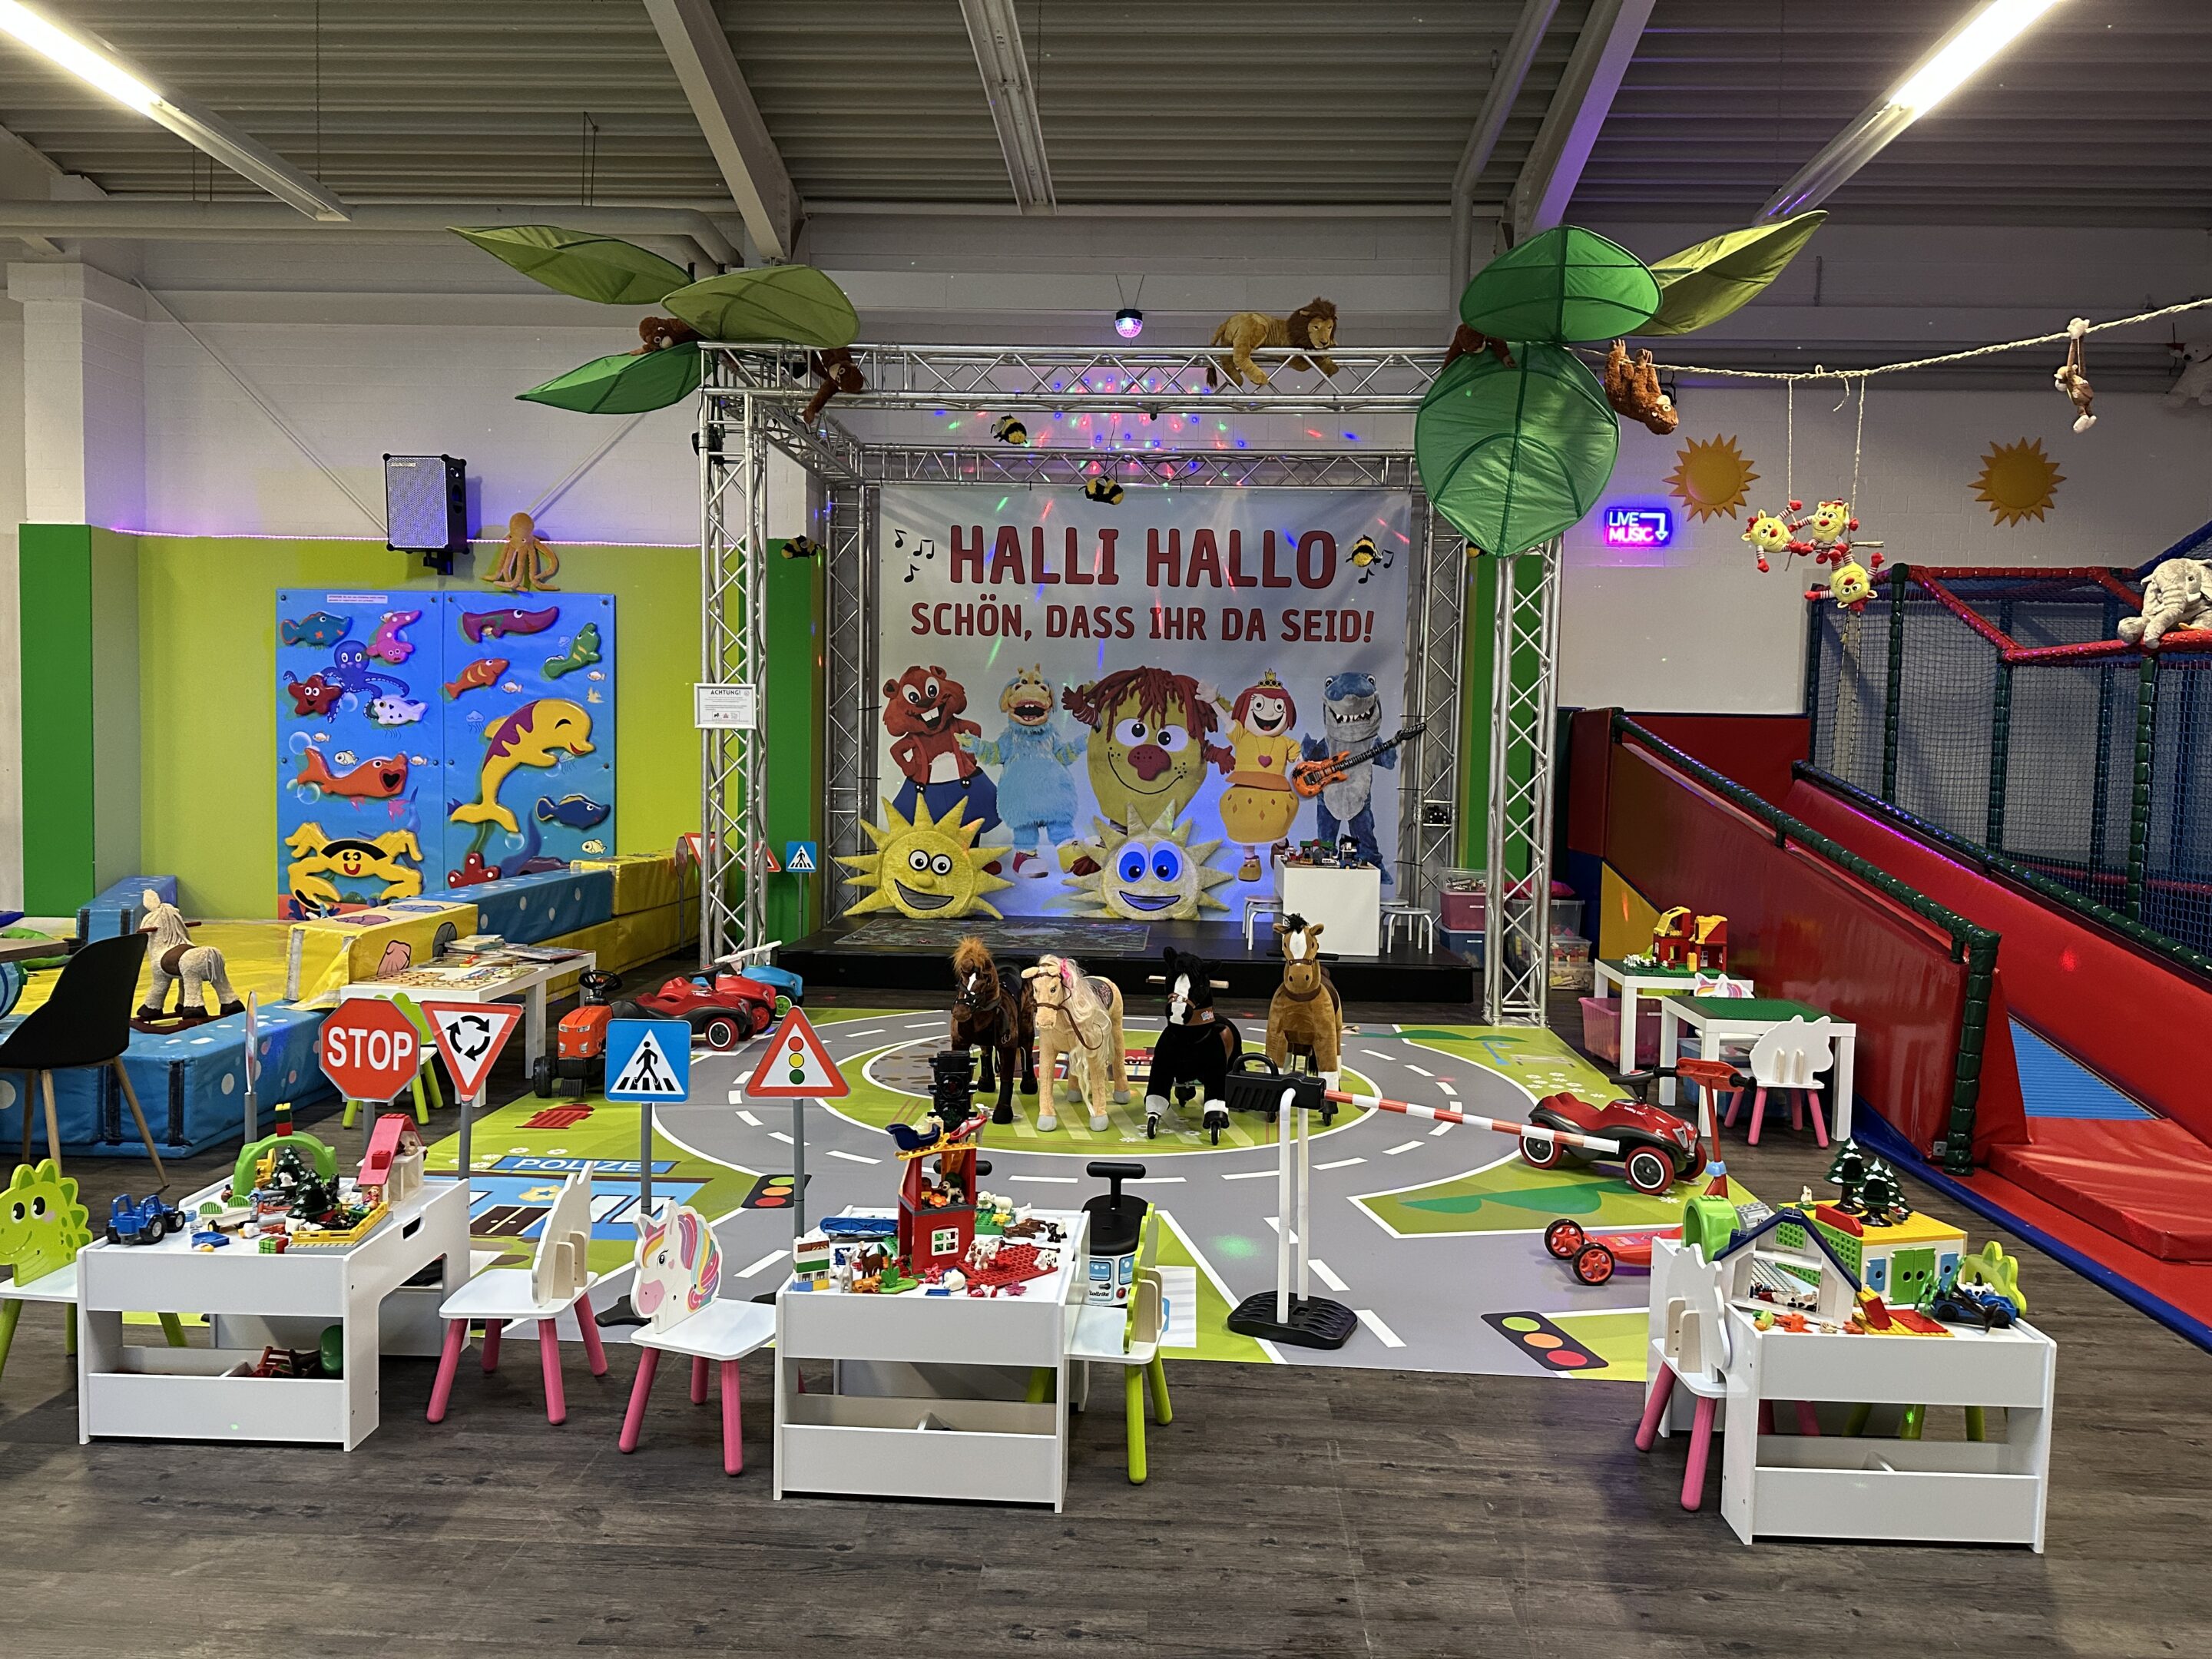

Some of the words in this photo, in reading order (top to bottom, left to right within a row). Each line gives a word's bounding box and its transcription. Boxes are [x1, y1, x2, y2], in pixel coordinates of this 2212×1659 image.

[1608, 527, 1654, 542] MUSIC
[1609, 512, 1640, 527] LIVE
[950, 525, 1120, 585] HALLI
[1146, 528, 1337, 590] HALLO
[911, 593, 1032, 642] SCHÖN,
[1046, 604, 1135, 639] DASS
[1149, 607, 1207, 641] IHR
[1221, 608, 1267, 641] DA
[1280, 608, 1375, 644] SEID!
[327, 1026, 413, 1071] STOP
[513, 1158, 656, 1171] POLIZE
